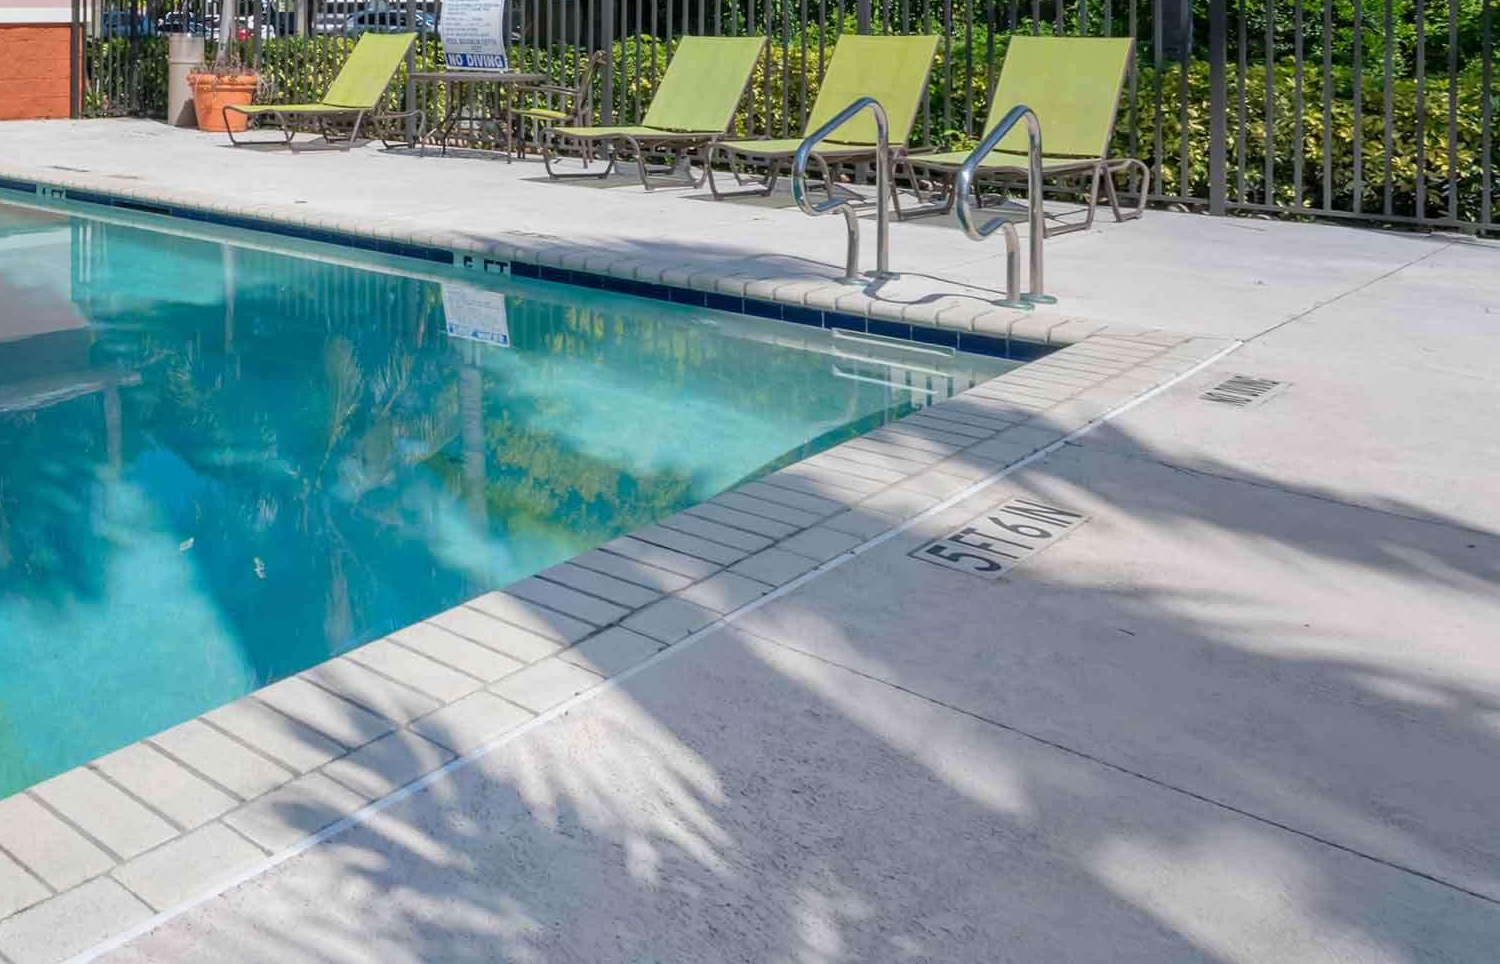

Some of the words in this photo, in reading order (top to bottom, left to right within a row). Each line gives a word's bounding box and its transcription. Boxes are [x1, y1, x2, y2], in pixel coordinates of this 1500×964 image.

[447, 53, 463, 66] NO
[467, 54, 503, 67] DIVING
[987, 516, 1053, 538] 6
[999, 499, 1083, 528] IN
[948, 527, 1035, 560] FT
[925, 544, 1002, 572] 5
